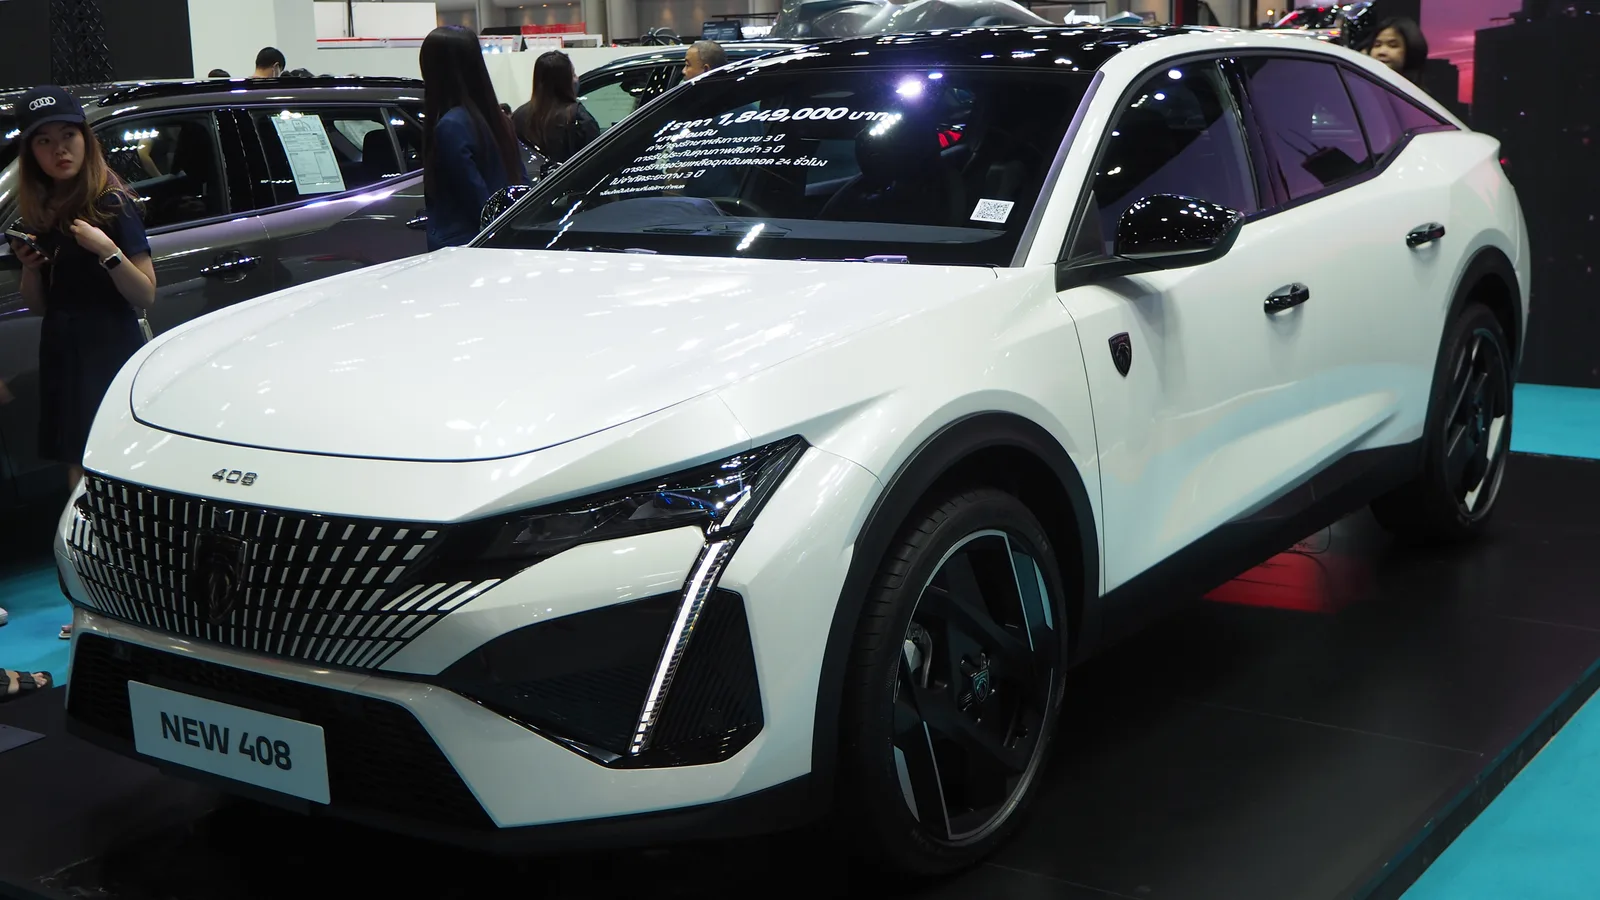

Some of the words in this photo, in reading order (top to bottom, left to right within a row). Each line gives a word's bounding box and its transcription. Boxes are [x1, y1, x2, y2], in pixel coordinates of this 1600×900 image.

[670, 118, 713, 131] ราคา
[718, 107, 849, 127] 1,849,000
[774, 133, 786, 142] ปี
[761, 146, 772, 154] 3
[772, 145, 786, 154] ปี
[775, 158, 792, 166] 24
[793, 155, 828, 167] ชั่วโมง
[683, 170, 694, 179] 3
[212, 468, 258, 486] 408
[160, 711, 229, 755] NEW
[238, 731, 292, 771] 408
